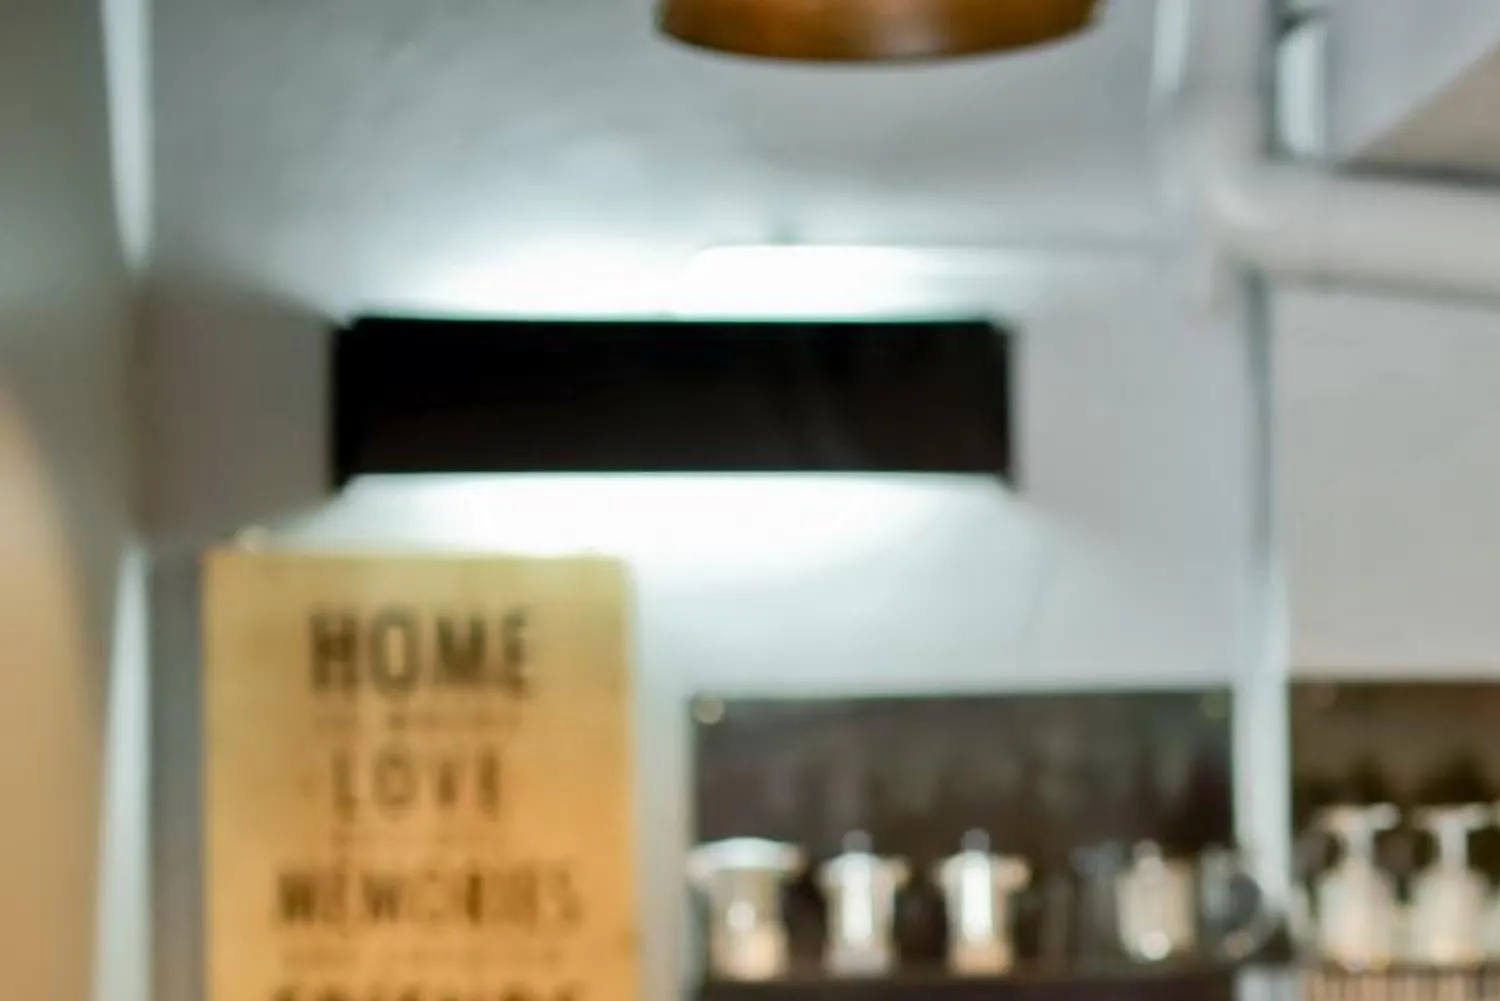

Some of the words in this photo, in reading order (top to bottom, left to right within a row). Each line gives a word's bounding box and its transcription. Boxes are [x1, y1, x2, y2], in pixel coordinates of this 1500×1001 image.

[310, 608, 538, 696] HOME
[330, 750, 508, 820] LOVE
[278, 868, 584, 928] MEMORIES
